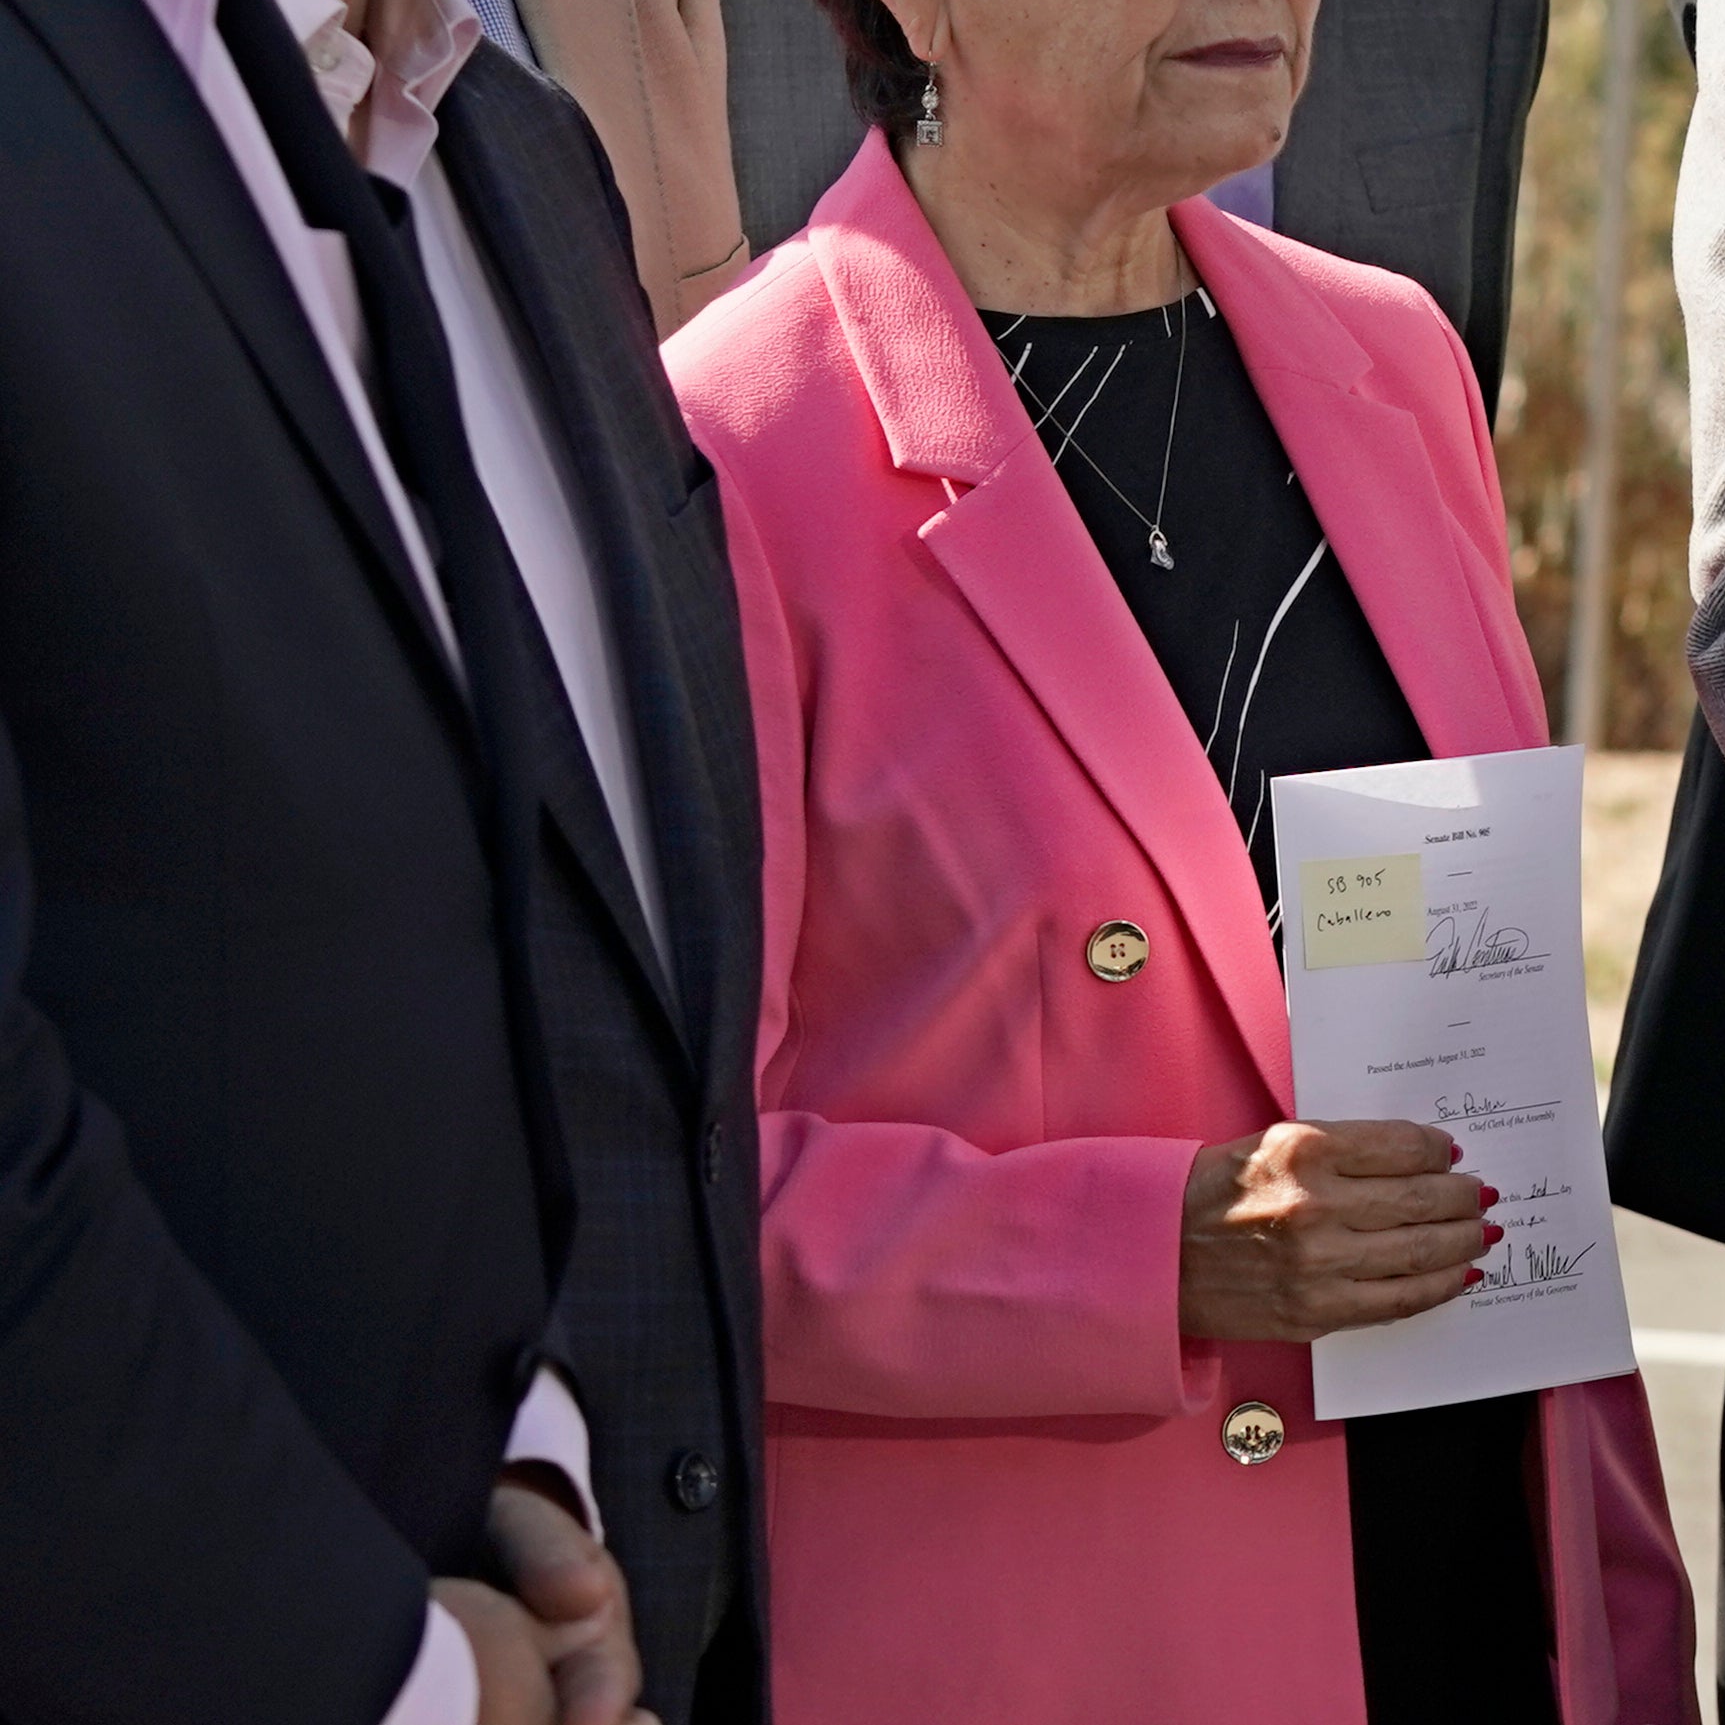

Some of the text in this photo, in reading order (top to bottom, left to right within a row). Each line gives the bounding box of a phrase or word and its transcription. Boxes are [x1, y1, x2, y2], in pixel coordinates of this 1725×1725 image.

[1424, 833, 1450, 844] Senate
[1452, 830, 1465, 841] Bill
[1327, 868, 1386, 894] SB 905
[1427, 906, 1451, 917] August
[1479, 970, 1506, 982] Secretary
[1524, 964, 1545, 974] Senate
[1367, 1063, 1393, 1074] Passed
[1394, 1061, 1405, 1071] the
[1405, 1056, 1434, 1069] Assembly
[1468, 1121, 1487, 1132] Chief
[1487, 1117, 1505, 1130] Clerk
[1524, 1109, 1556, 1122] Assembly
[1470, 1297, 1494, 1310] Private
[1494, 1292, 1525, 1306] Secretary
[1545, 1283, 1578, 1296] Governor
